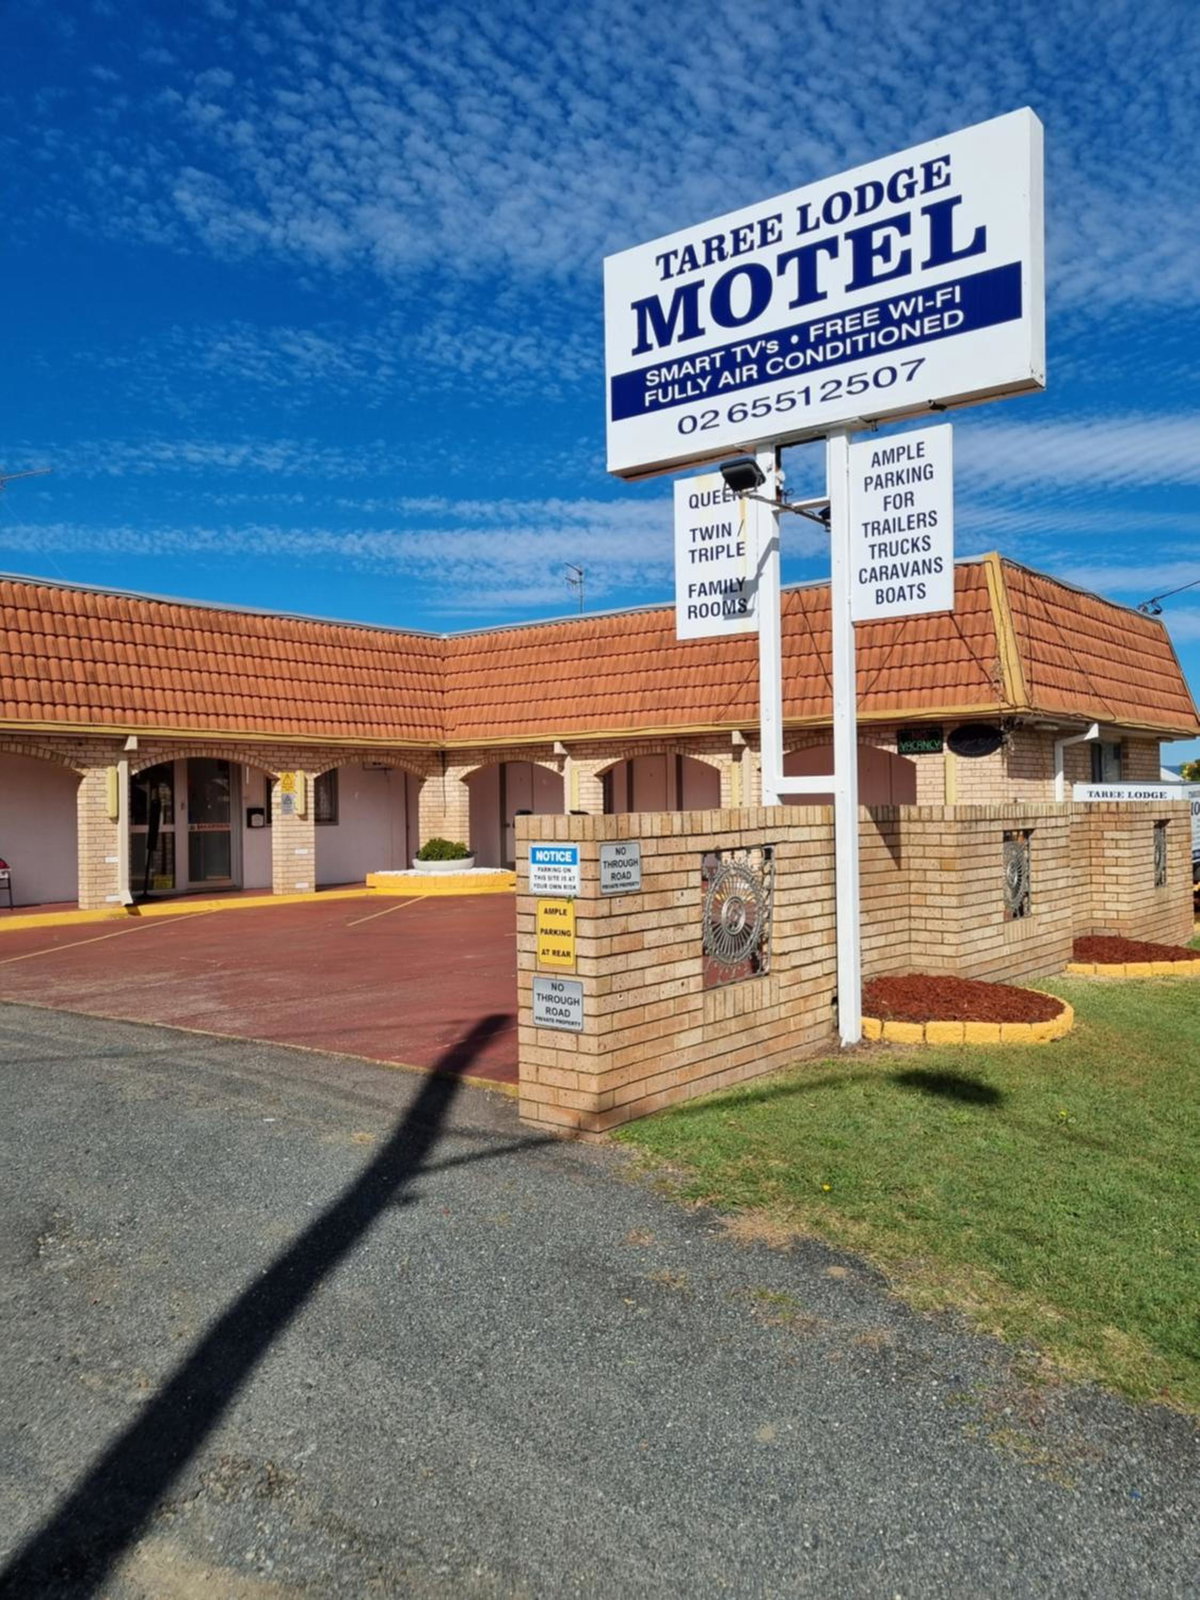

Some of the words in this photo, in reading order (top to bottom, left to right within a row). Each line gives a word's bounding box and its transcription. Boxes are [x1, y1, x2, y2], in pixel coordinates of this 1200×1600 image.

[656, 213, 783, 281] TAREE
[796, 154, 951, 236] LODGE
[631, 194, 987, 356] MOTEL
[645, 351, 725, 387] SMART
[731, 339, 780, 364] TV's
[809, 311, 881, 343] FREE
[889, 285, 961, 319] WI-FI
[644, 376, 712, 407] FULLY
[718, 365, 759, 388] AIR
[768, 308, 965, 376] CONDITIONED
[677, 410, 721, 435] 02
[871, 441, 926, 468] AMPLE
[864, 463, 934, 492] PARKING
[883, 491, 915, 512] FOR
[689, 522, 732, 543] TWIN
[862, 510, 938, 539] TRAILERS
[689, 541, 746, 564] TRIPLE
[869, 535, 931, 560] TRUCKS
[858, 556, 944, 585] CARAVANS
[688, 576, 747, 599] FAMILY
[875, 582, 927, 605] BOATS
[687, 598, 748, 620] ROOMS
[1087, 790, 1125, 799] TAREE
[1128, 790, 1168, 800] LODGE
[535, 850, 573, 863] NOTICE
[615, 847, 626, 856] NO
[603, 858, 639, 870] THROUGH
[611, 871, 632, 881] ROAD
[543, 907, 567, 916] AMPLE
[540, 928, 572, 937] PARKING
[541, 948, 550, 956] AT
[552, 949, 571, 958] REAR
[551, 982, 565, 992] NO
[536, 993, 580, 1006] THROUGH
[545, 1006, 571, 1018] ROAD
